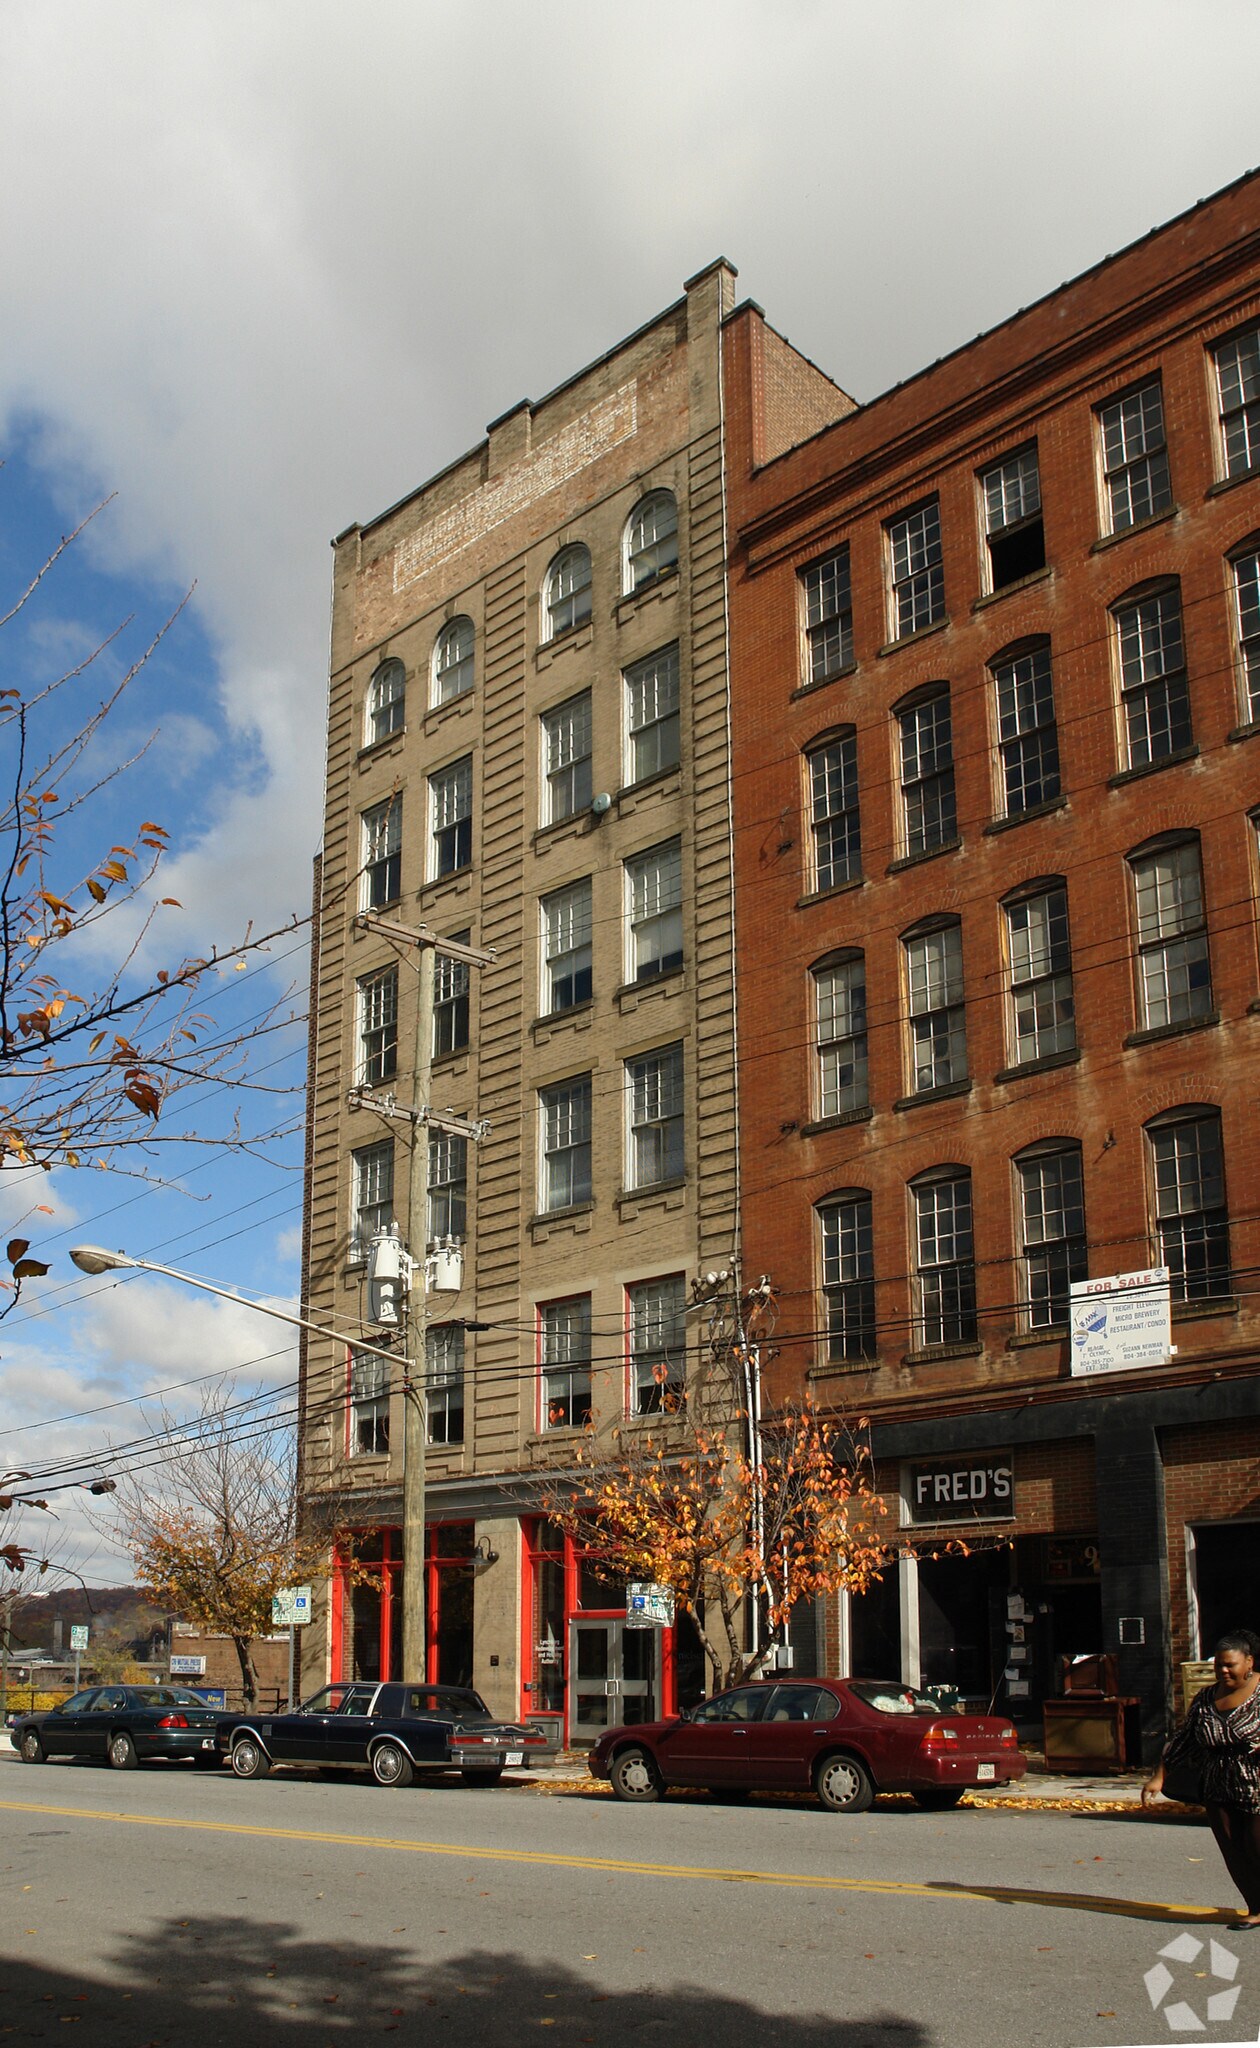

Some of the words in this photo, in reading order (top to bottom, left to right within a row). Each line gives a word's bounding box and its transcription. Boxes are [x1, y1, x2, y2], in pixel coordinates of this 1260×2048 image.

[1086, 1282, 1112, 1294] FOR
[1118, 1274, 1152, 1289] SALE
[1112, 1303, 1134, 1313] FREIGHT
[1136, 1299, 1162, 1309] ELEVATOR
[1115, 1313, 1132, 1322] MICRO
[1134, 1309, 1160, 1320] BREWERY
[1142, 1341, 1164, 1350] NEWMAN
[916, 1467, 1011, 1504] FRED'S
[207, 1694, 221, 1703] New
